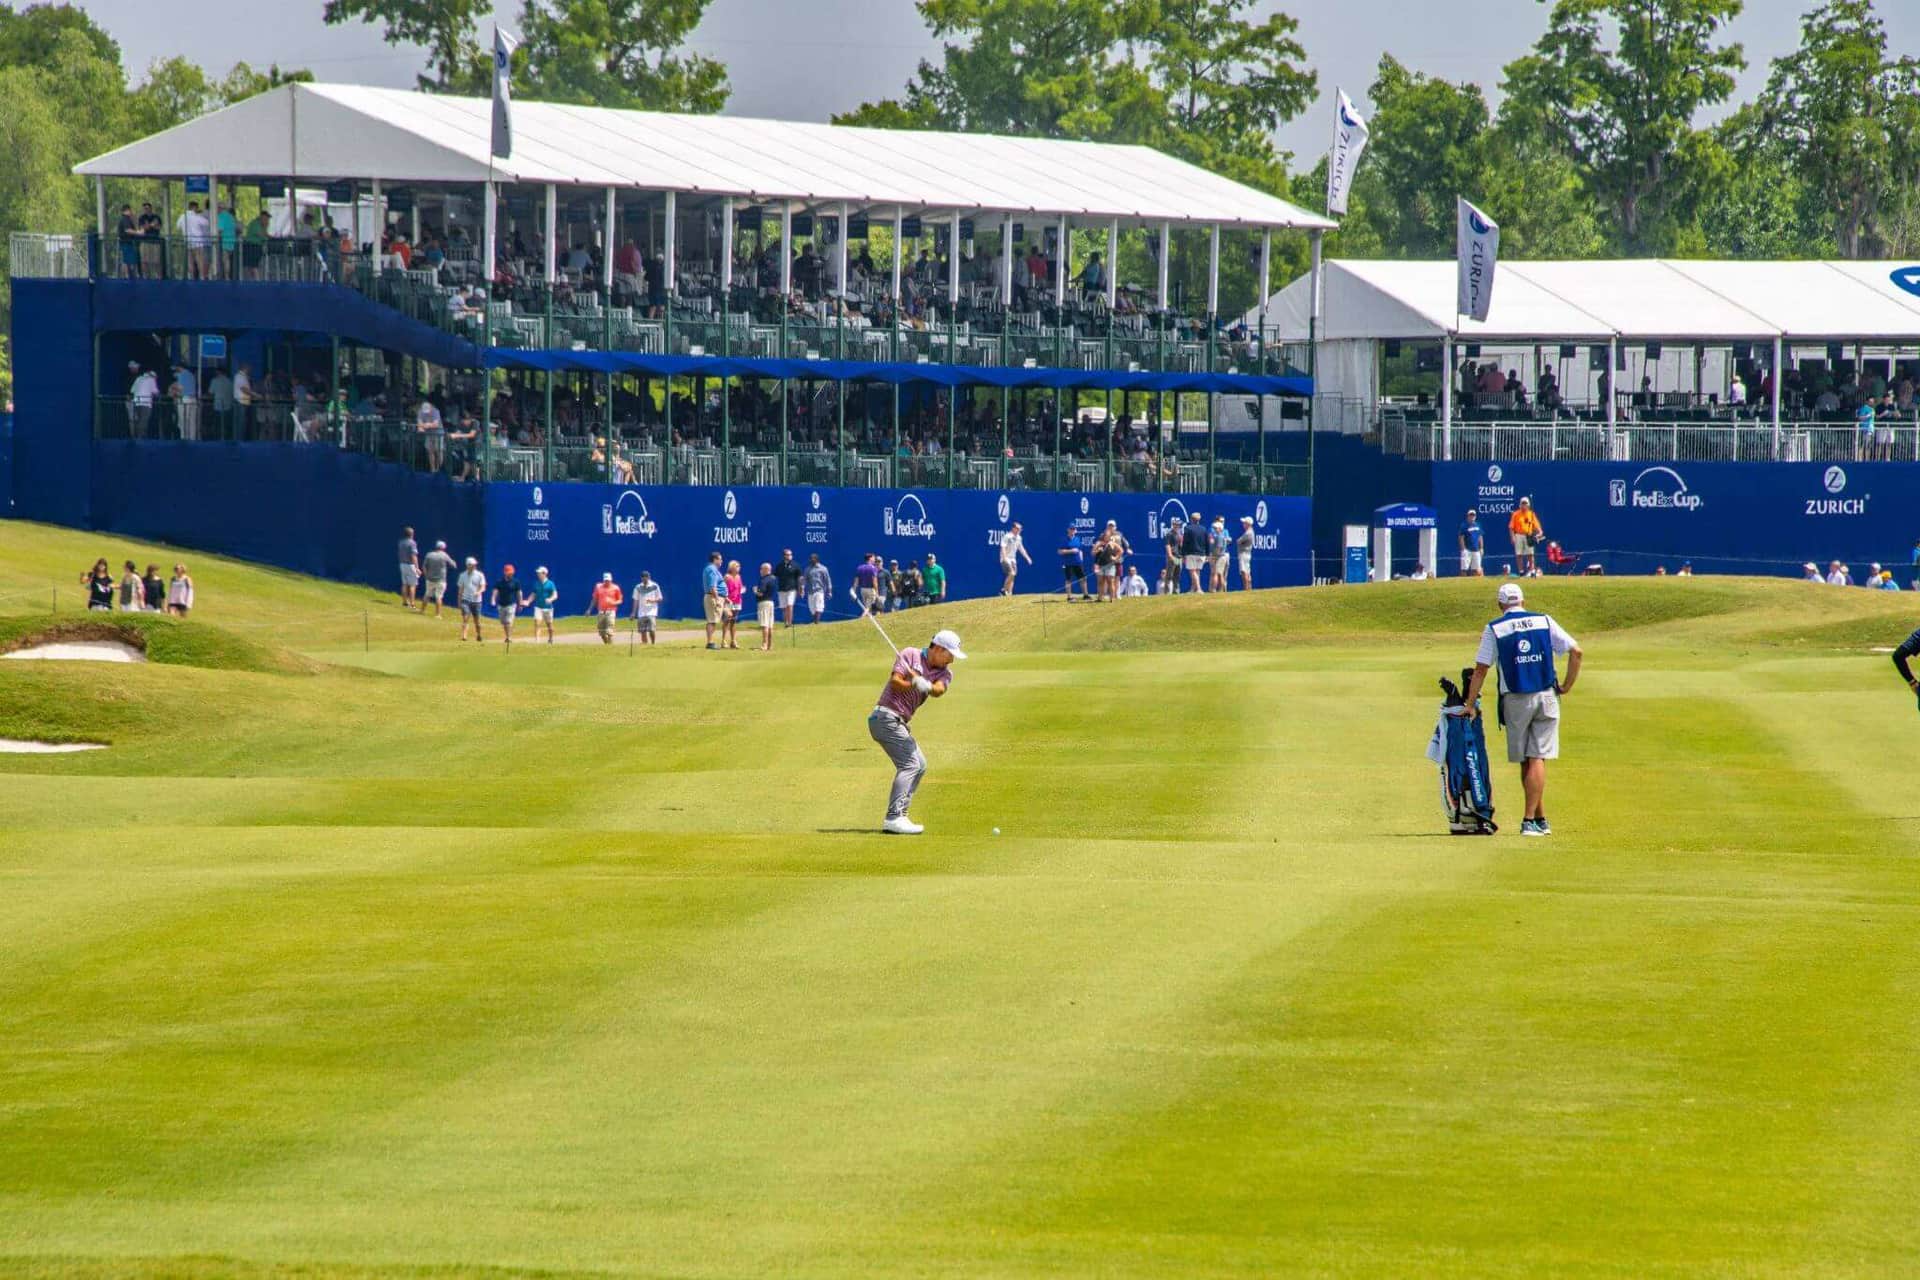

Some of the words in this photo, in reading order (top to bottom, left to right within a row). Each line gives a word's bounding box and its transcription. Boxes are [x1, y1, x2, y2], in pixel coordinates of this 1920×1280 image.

[1478, 485, 1514, 496] ZURICH
[1633, 490, 1701, 511] FedExCup
[1805, 499, 1864, 514] ZURICH
[1478, 503, 1514, 513] CLASSIC
[527, 509, 550, 520] ZURICH
[805, 512, 827, 523] ZURICH
[527, 529, 550, 541] CLASSIC
[713, 526, 748, 544] ZURICH
[805, 531, 827, 543] CLASSIC
[1253, 534, 1277, 550] URICH
